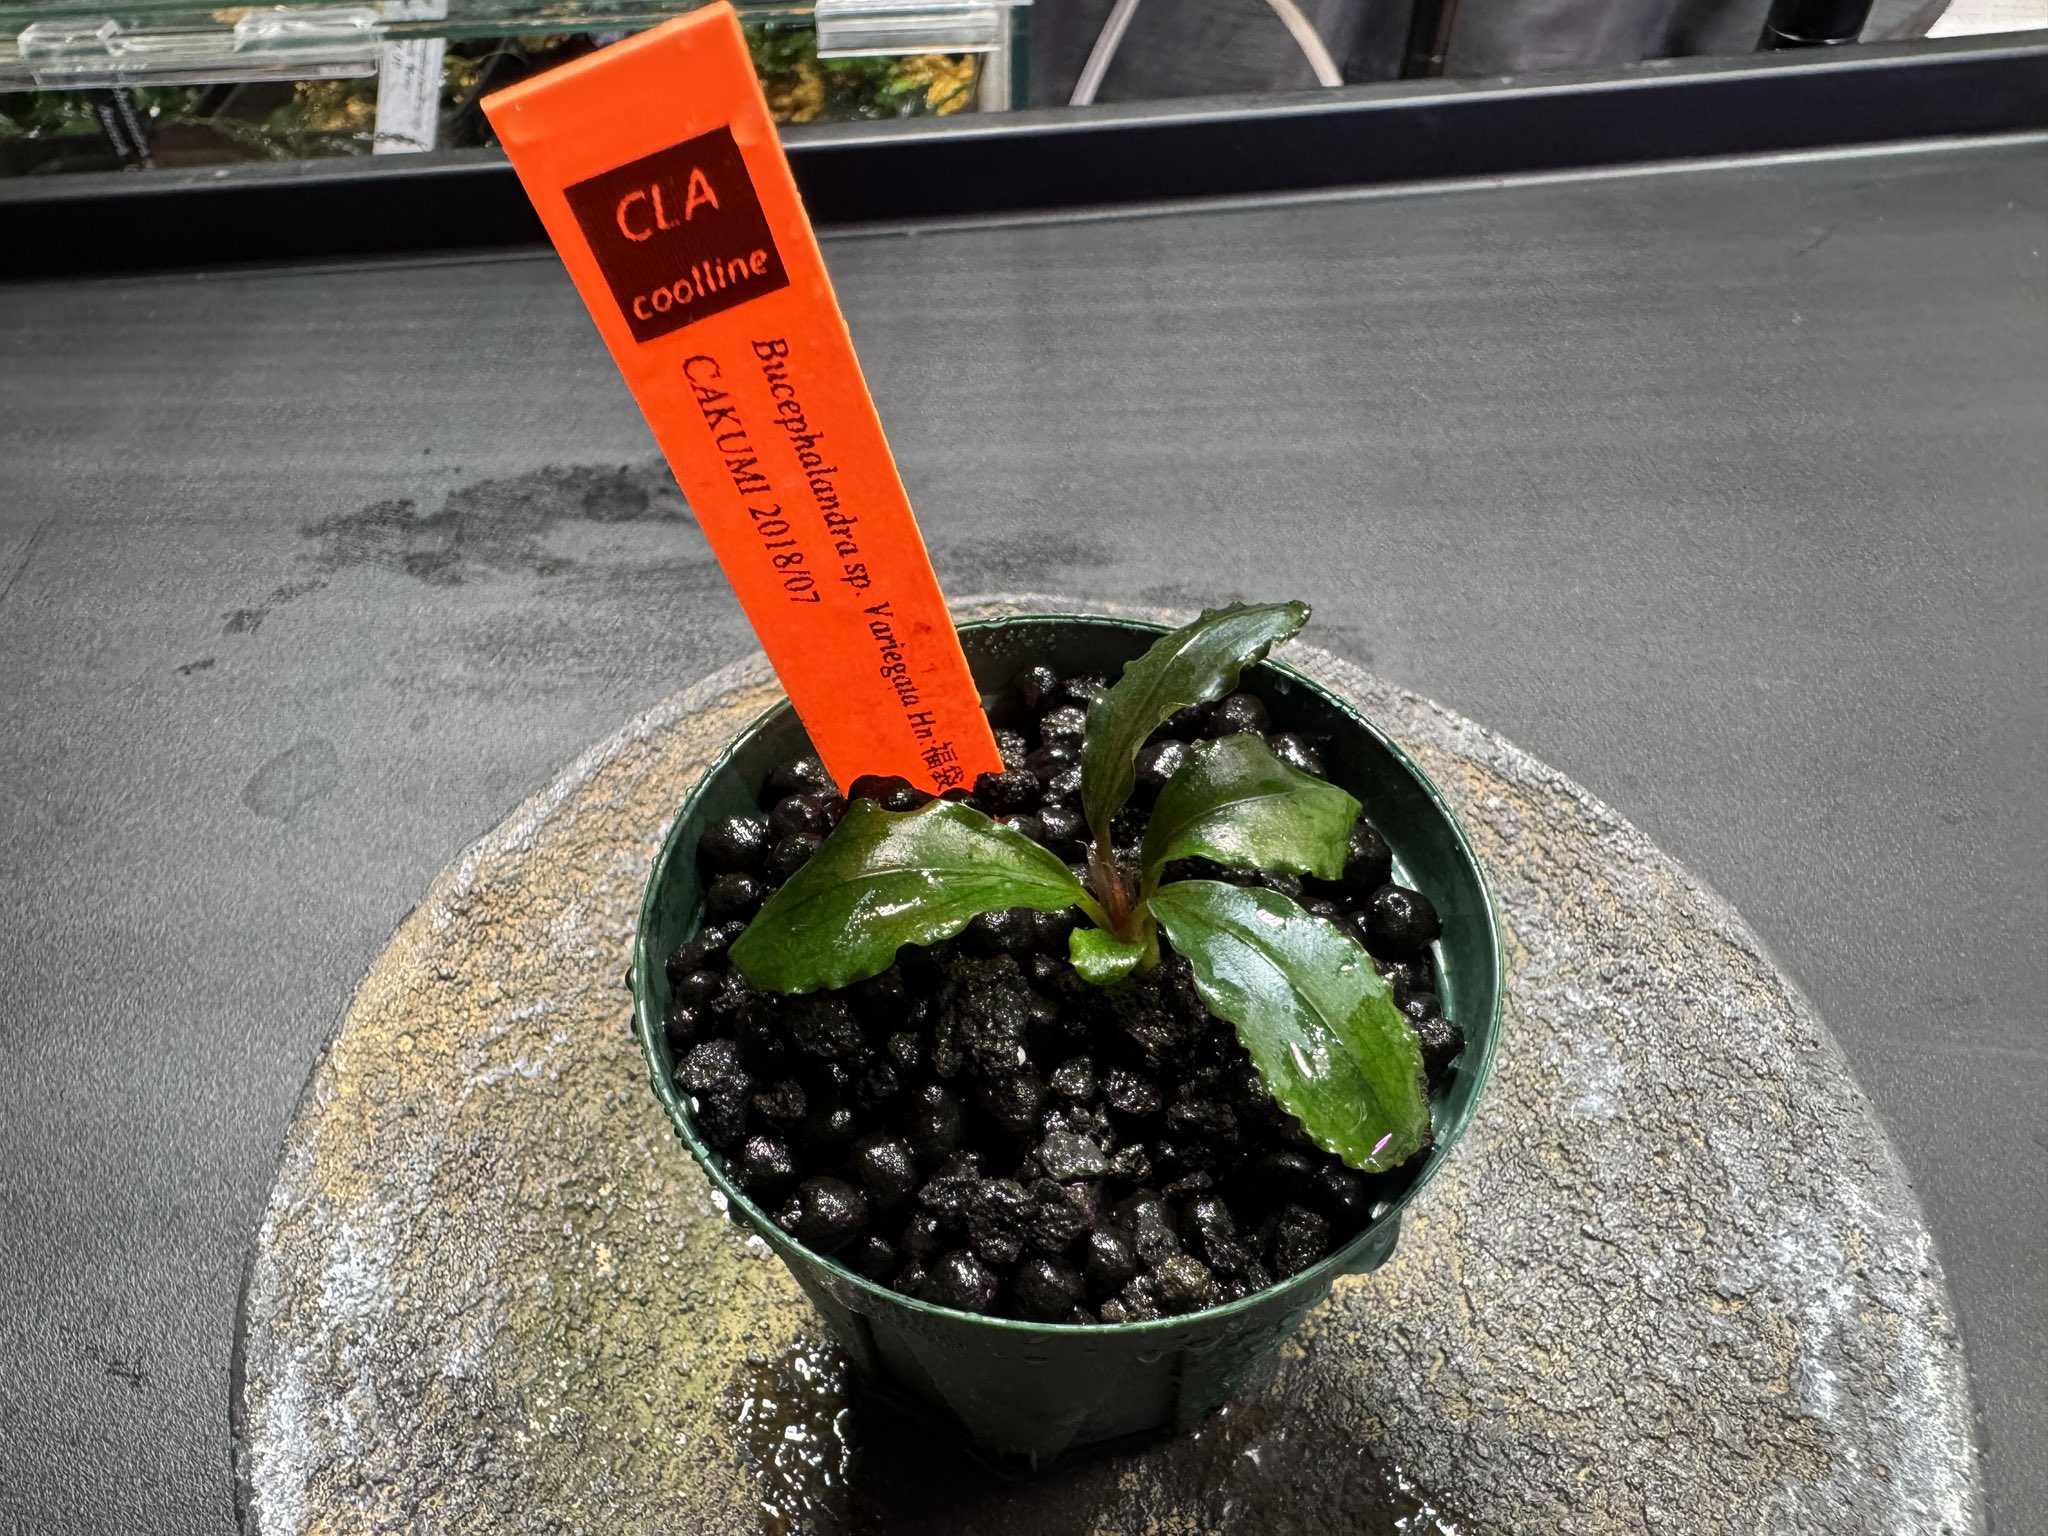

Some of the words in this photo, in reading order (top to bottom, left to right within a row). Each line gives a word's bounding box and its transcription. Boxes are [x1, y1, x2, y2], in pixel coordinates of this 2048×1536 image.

[616, 167, 720, 242] CLA
[633, 249, 768, 320] coolline
[682, 355, 771, 496] CAKUMI
[748, 503, 821, 603] 2018/07
[752, 338, 859, 558] Bucephalandra
[840, 563, 872, 597] sp.
[863, 601, 919, 708] Variegata
